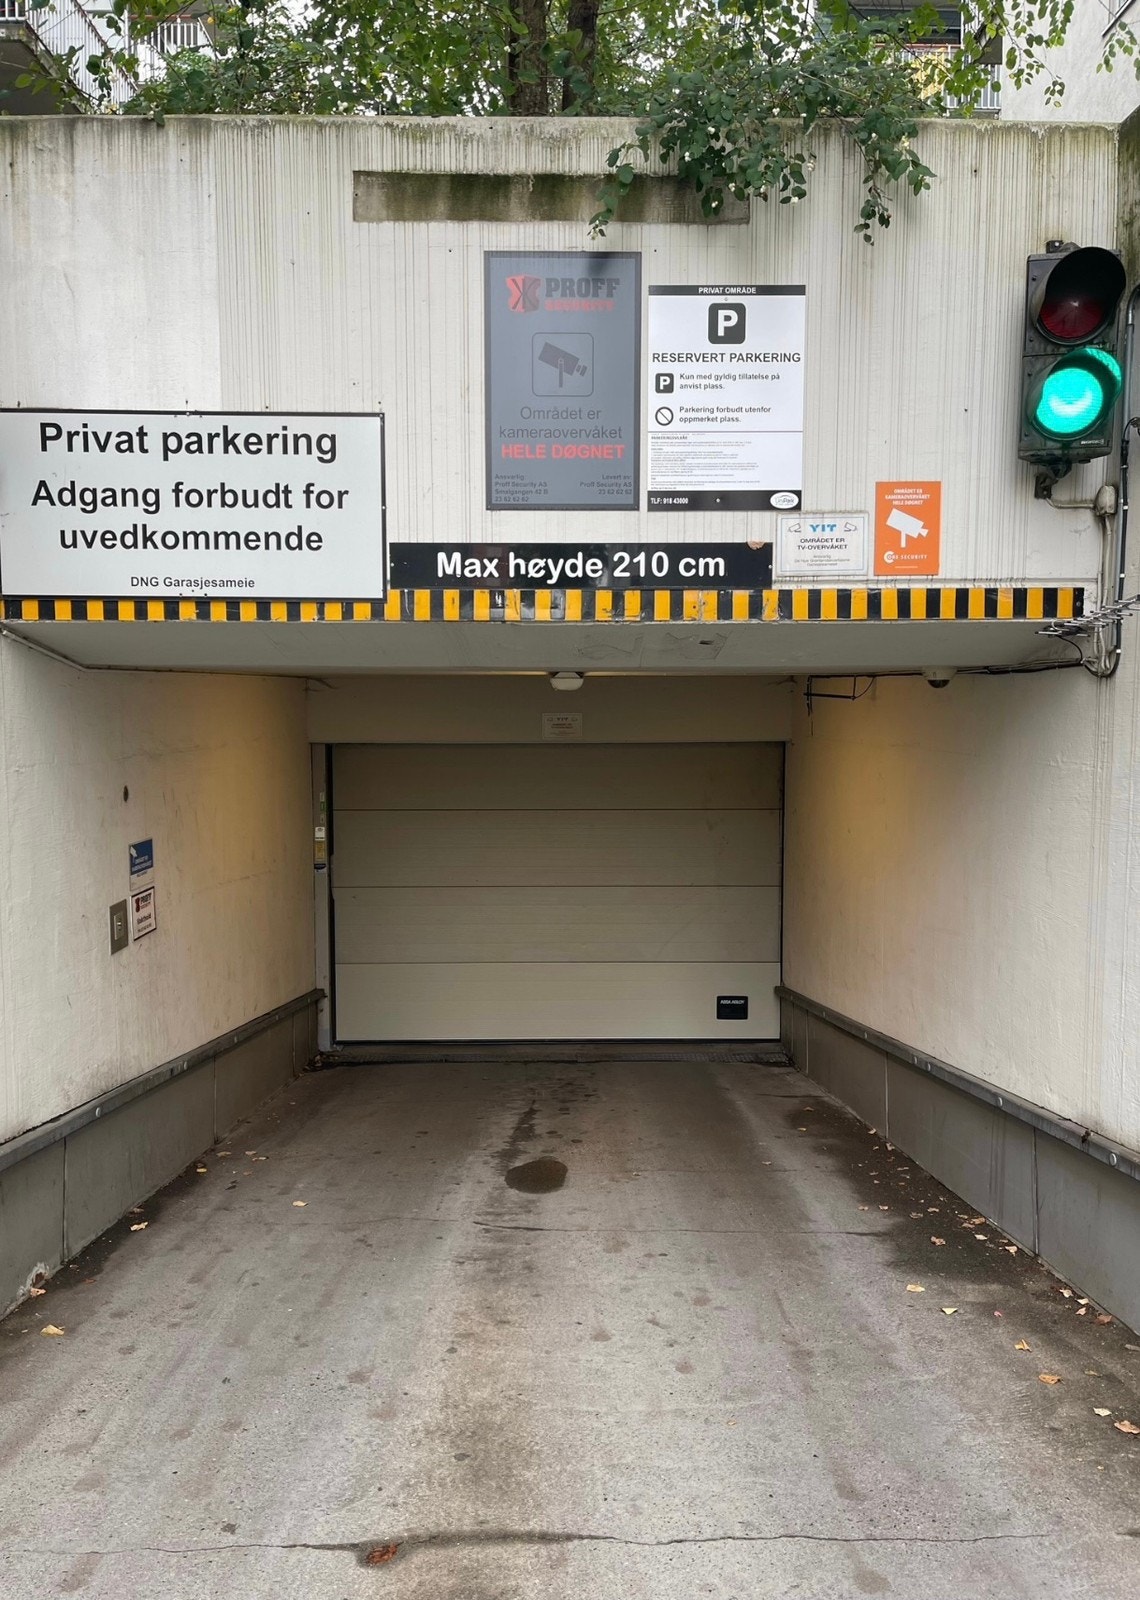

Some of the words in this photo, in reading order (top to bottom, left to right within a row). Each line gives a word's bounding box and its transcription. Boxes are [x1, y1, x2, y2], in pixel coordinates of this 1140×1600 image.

[545, 278, 620, 298] PROFF
[725, 286, 757, 294] OMRÅDE
[717, 309, 739, 337] P
[652, 352, 726, 363] RESERVERT
[729, 352, 801, 363] PARKERING
[714, 373, 737, 381] gyldig
[771, 373, 780, 382] på
[703, 382, 725, 390] plass.
[520, 406, 583, 420] Området
[587, 409, 603, 420] er
[679, 406, 714, 414] Parkering
[679, 415, 718, 423] oppmerket
[719, 415, 741, 423] plass.
[499, 425, 623, 439] kameraovervåket
[39, 422, 149, 454] Privat
[162, 425, 338, 464] parkering
[501, 443, 546, 459] HELE
[551, 443, 626, 459] DØGNET
[31, 480, 161, 515] Adgang
[172, 481, 294, 510] forbudt
[303, 482, 350, 510] for
[810, 524, 837, 532] YIT
[59, 523, 324, 552] uvedkommende
[797, 543, 848, 551] TV-OVERVÅKET
[436, 551, 500, 578] Max
[509, 551, 603, 585] høyde
[612, 551, 669, 578] 210
[678, 556, 726, 578] cm
[130, 576, 159, 588] DNG
[163, 576, 255, 591] Garasjesameie
